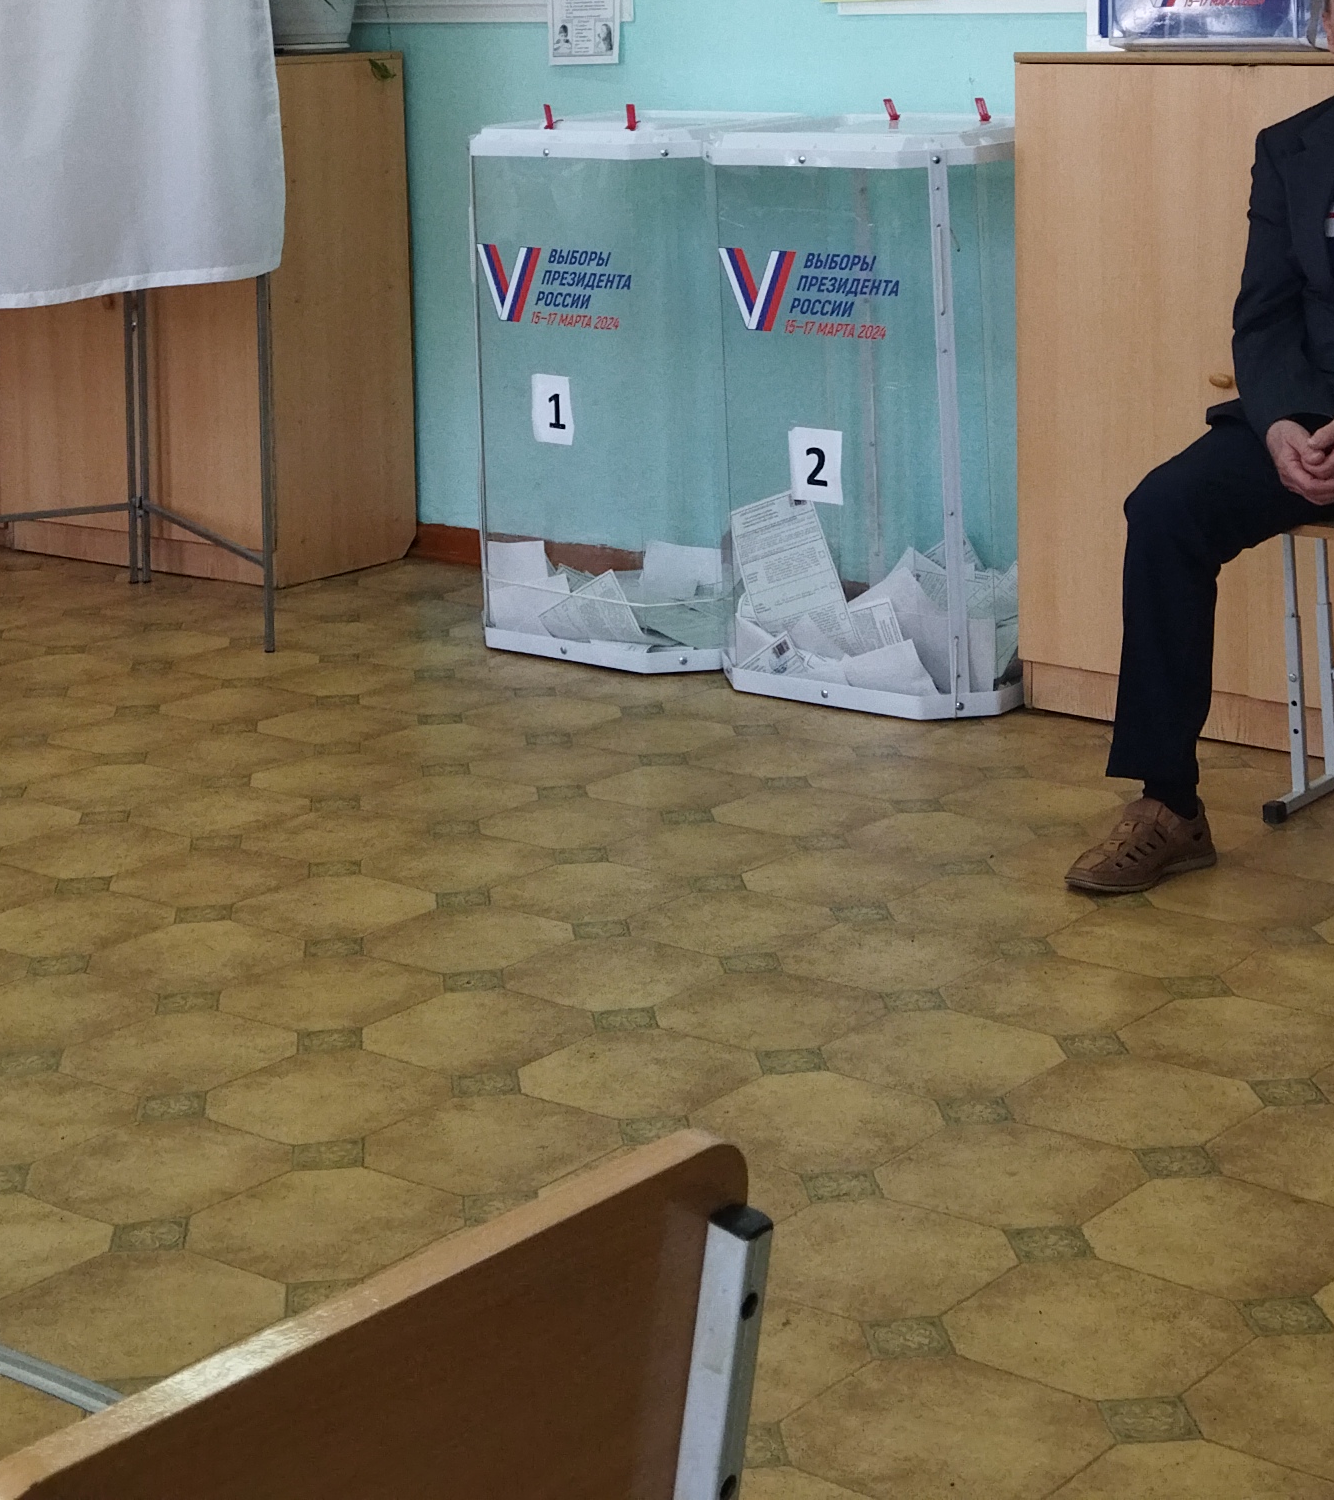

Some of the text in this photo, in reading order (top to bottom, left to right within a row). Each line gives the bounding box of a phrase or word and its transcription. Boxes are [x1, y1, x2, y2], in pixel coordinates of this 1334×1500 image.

[548, 249, 611, 267] ВЫБОРЫ
[804, 253, 876, 272] ВЫБОРЫ
[541, 270, 632, 290] ПРЕЗИДЕНТА
[797, 275, 900, 297] ПРЕЗИДЕНТА
[535, 291, 591, 309] РОССИИ
[789, 297, 855, 318] РОССИИ
[559, 313, 592, 328] МАРТА
[594, 316, 619, 330] 2024
[817, 322, 856, 338] МАРТА
[857, 324, 886, 340] 2024
[548, 393, 566, 430] 1
[805, 447, 828, 488] 2
